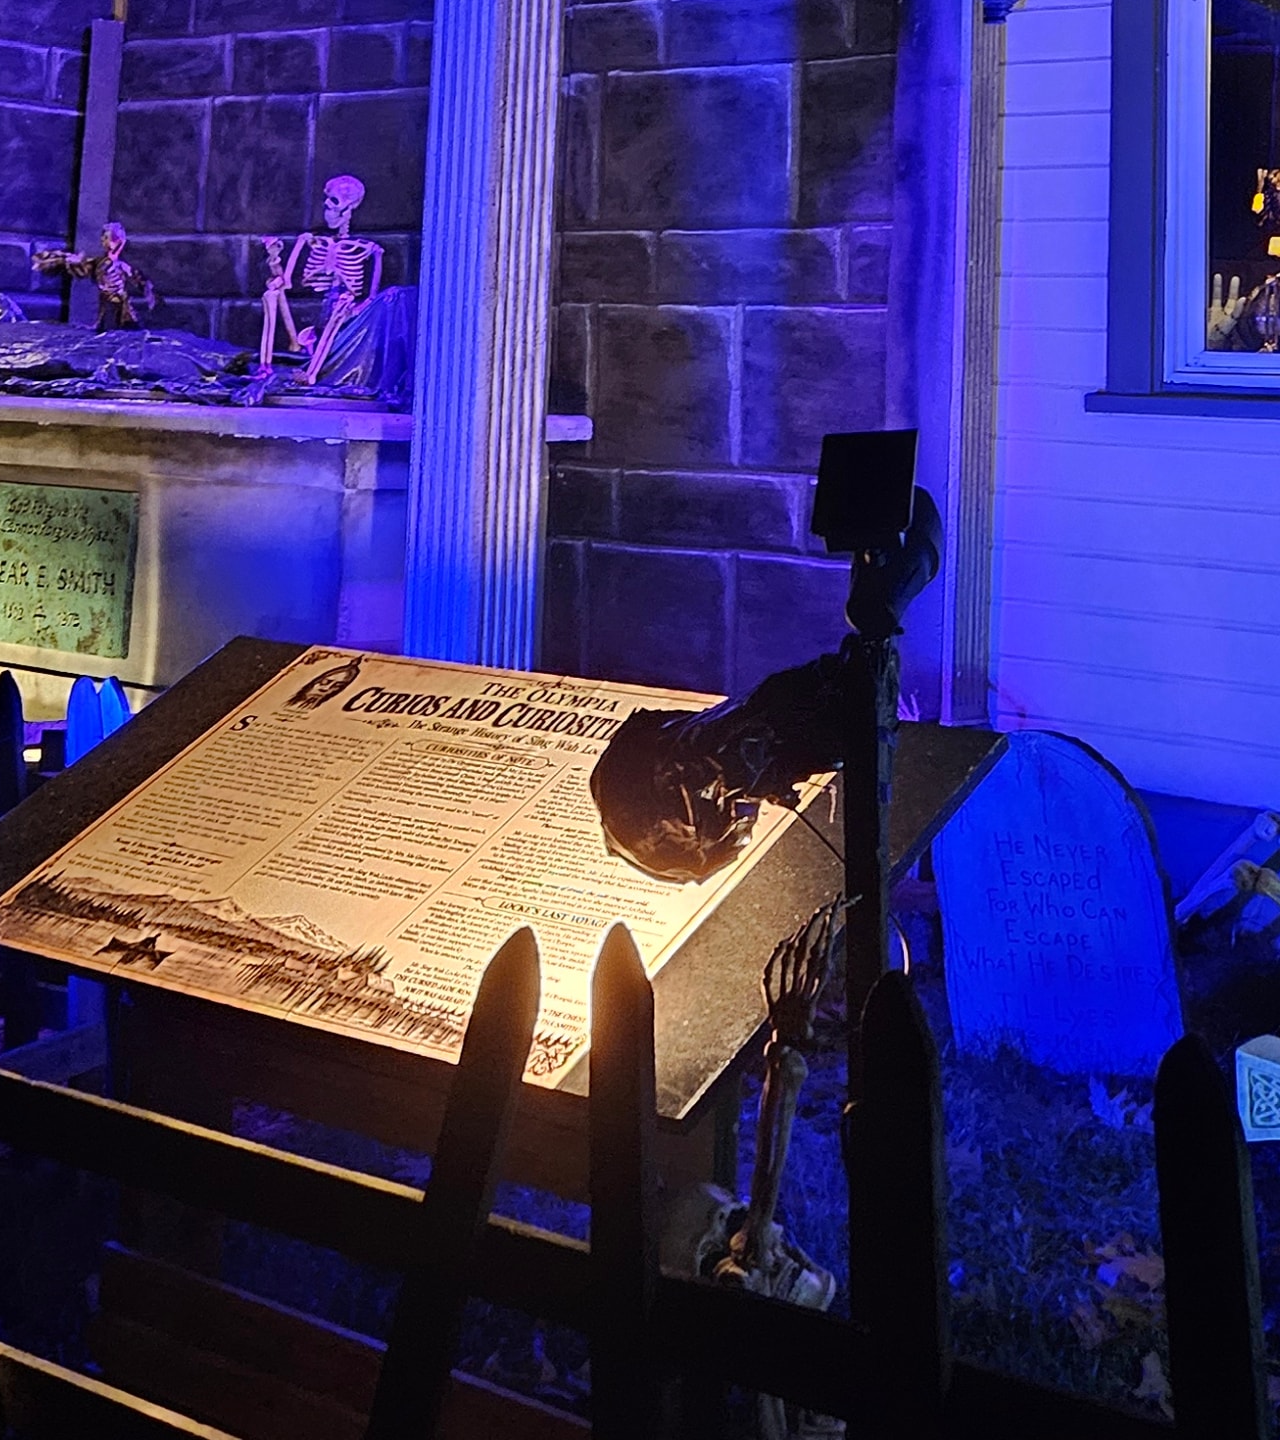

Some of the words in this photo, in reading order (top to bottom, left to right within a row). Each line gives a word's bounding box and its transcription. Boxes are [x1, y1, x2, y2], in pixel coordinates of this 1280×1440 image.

[57, 568, 116, 596] SMITH
[480, 681, 527, 700] THE
[527, 687, 621, 713] OLYMPIA
[342, 686, 448, 719] CURIOS
[441, 697, 501, 723] AND
[492, 702, 621, 741] CURIOSITI
[407, 719, 427, 729] The
[427, 722, 469, 735] Strange
[470, 727, 511, 742] History
[511, 734, 528, 743] of
[525, 735, 552, 749] Sing
[555, 740, 579, 752] Wah
[426, 743, 489, 758] CURIOSITIES
[505, 756, 535, 766] NOTE
[542, 910, 567, 920] LAST
